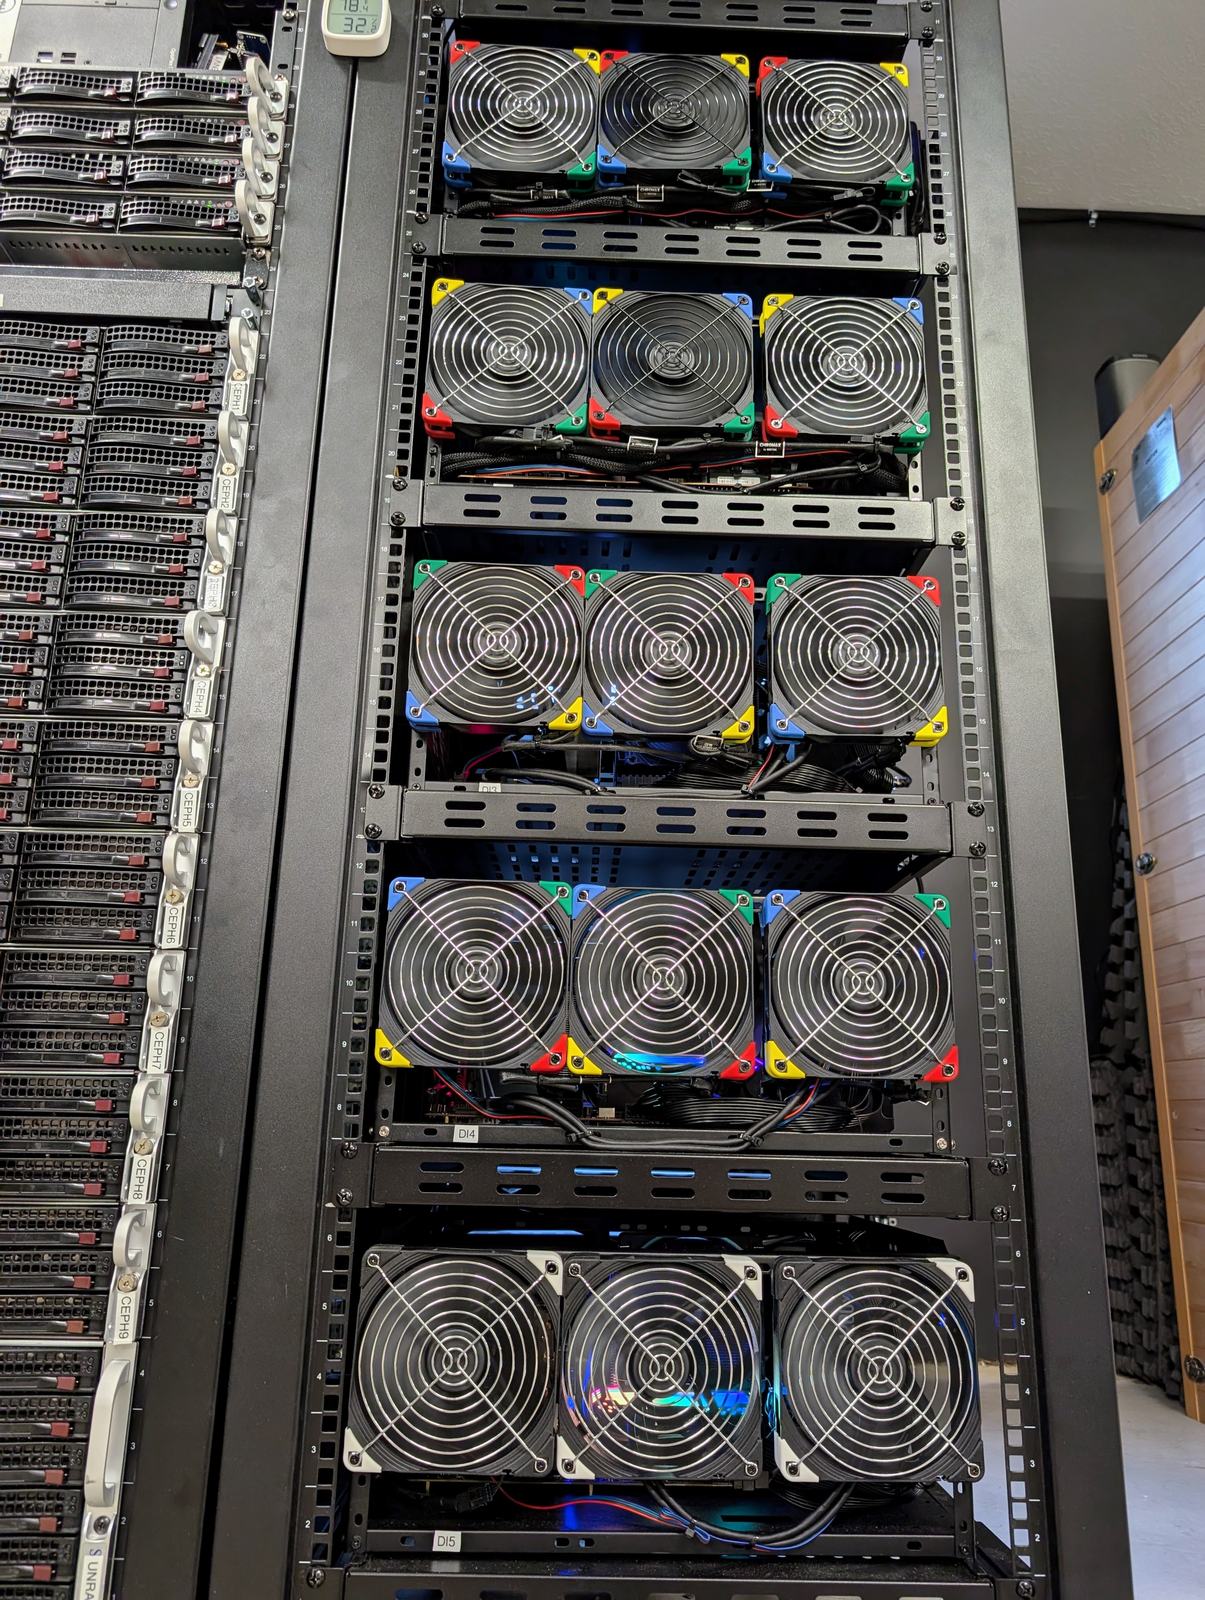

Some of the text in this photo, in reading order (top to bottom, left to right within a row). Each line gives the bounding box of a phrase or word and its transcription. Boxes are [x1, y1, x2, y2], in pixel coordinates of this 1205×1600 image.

[232, 382, 242, 411] CEPH1
[220, 478, 232, 509] CEPH2
[194, 680, 207, 714] CEPH4
[182, 792, 194, 828] CEPH5
[166, 907, 179, 944] CEPH6
[152, 1031, 165, 1071] CEPH7
[458, 1128, 475, 1139] DI4
[132, 1158, 148, 1200] CEPH8
[327, 1234, 333, 1242] 6
[118, 1295, 132, 1339] CEPH9
[130, 1442, 136, 1450] 3
[311, 1446, 317, 1454] 3
[1030, 1460, 1035, 1468] 3
[305, 1520, 311, 1528] 2
[437, 1535, 456, 1547] DI5
[1035, 1534, 1041, 1542] 2
